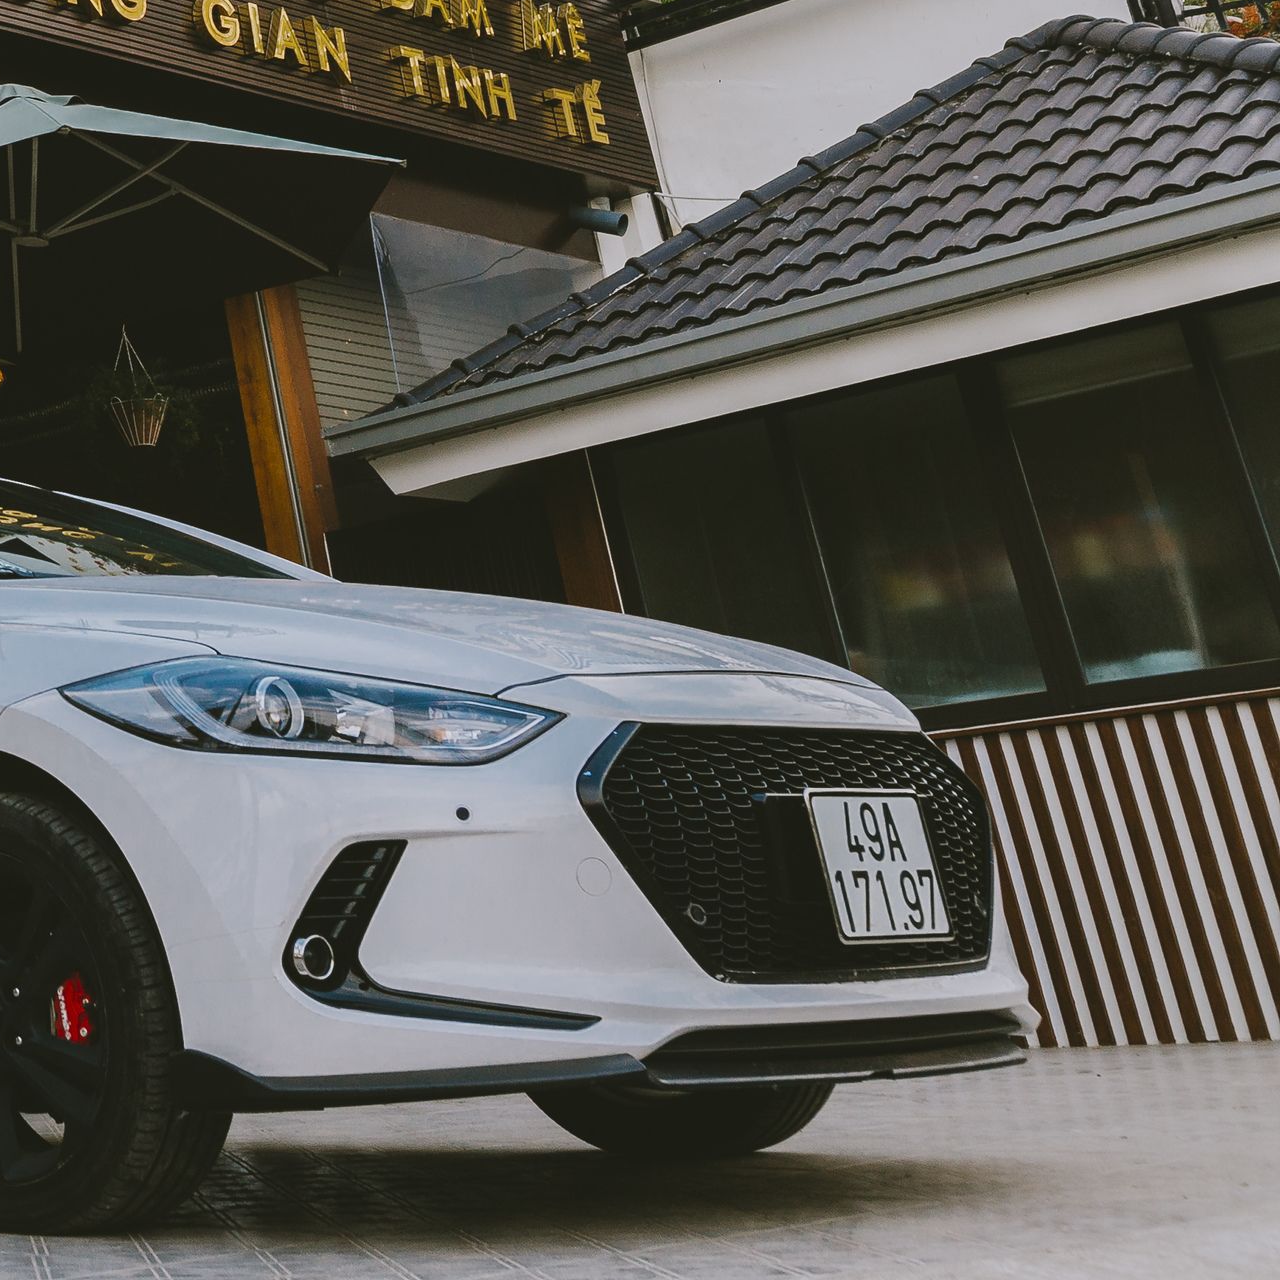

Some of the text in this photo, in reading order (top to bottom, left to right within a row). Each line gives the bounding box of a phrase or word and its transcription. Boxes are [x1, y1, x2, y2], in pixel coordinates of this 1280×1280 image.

[391, 45, 517, 121] TINH
[543, 79, 610, 145] TẾ
[843, 801, 907, 862] 49A
[835, 869, 936, 933] 171.97
